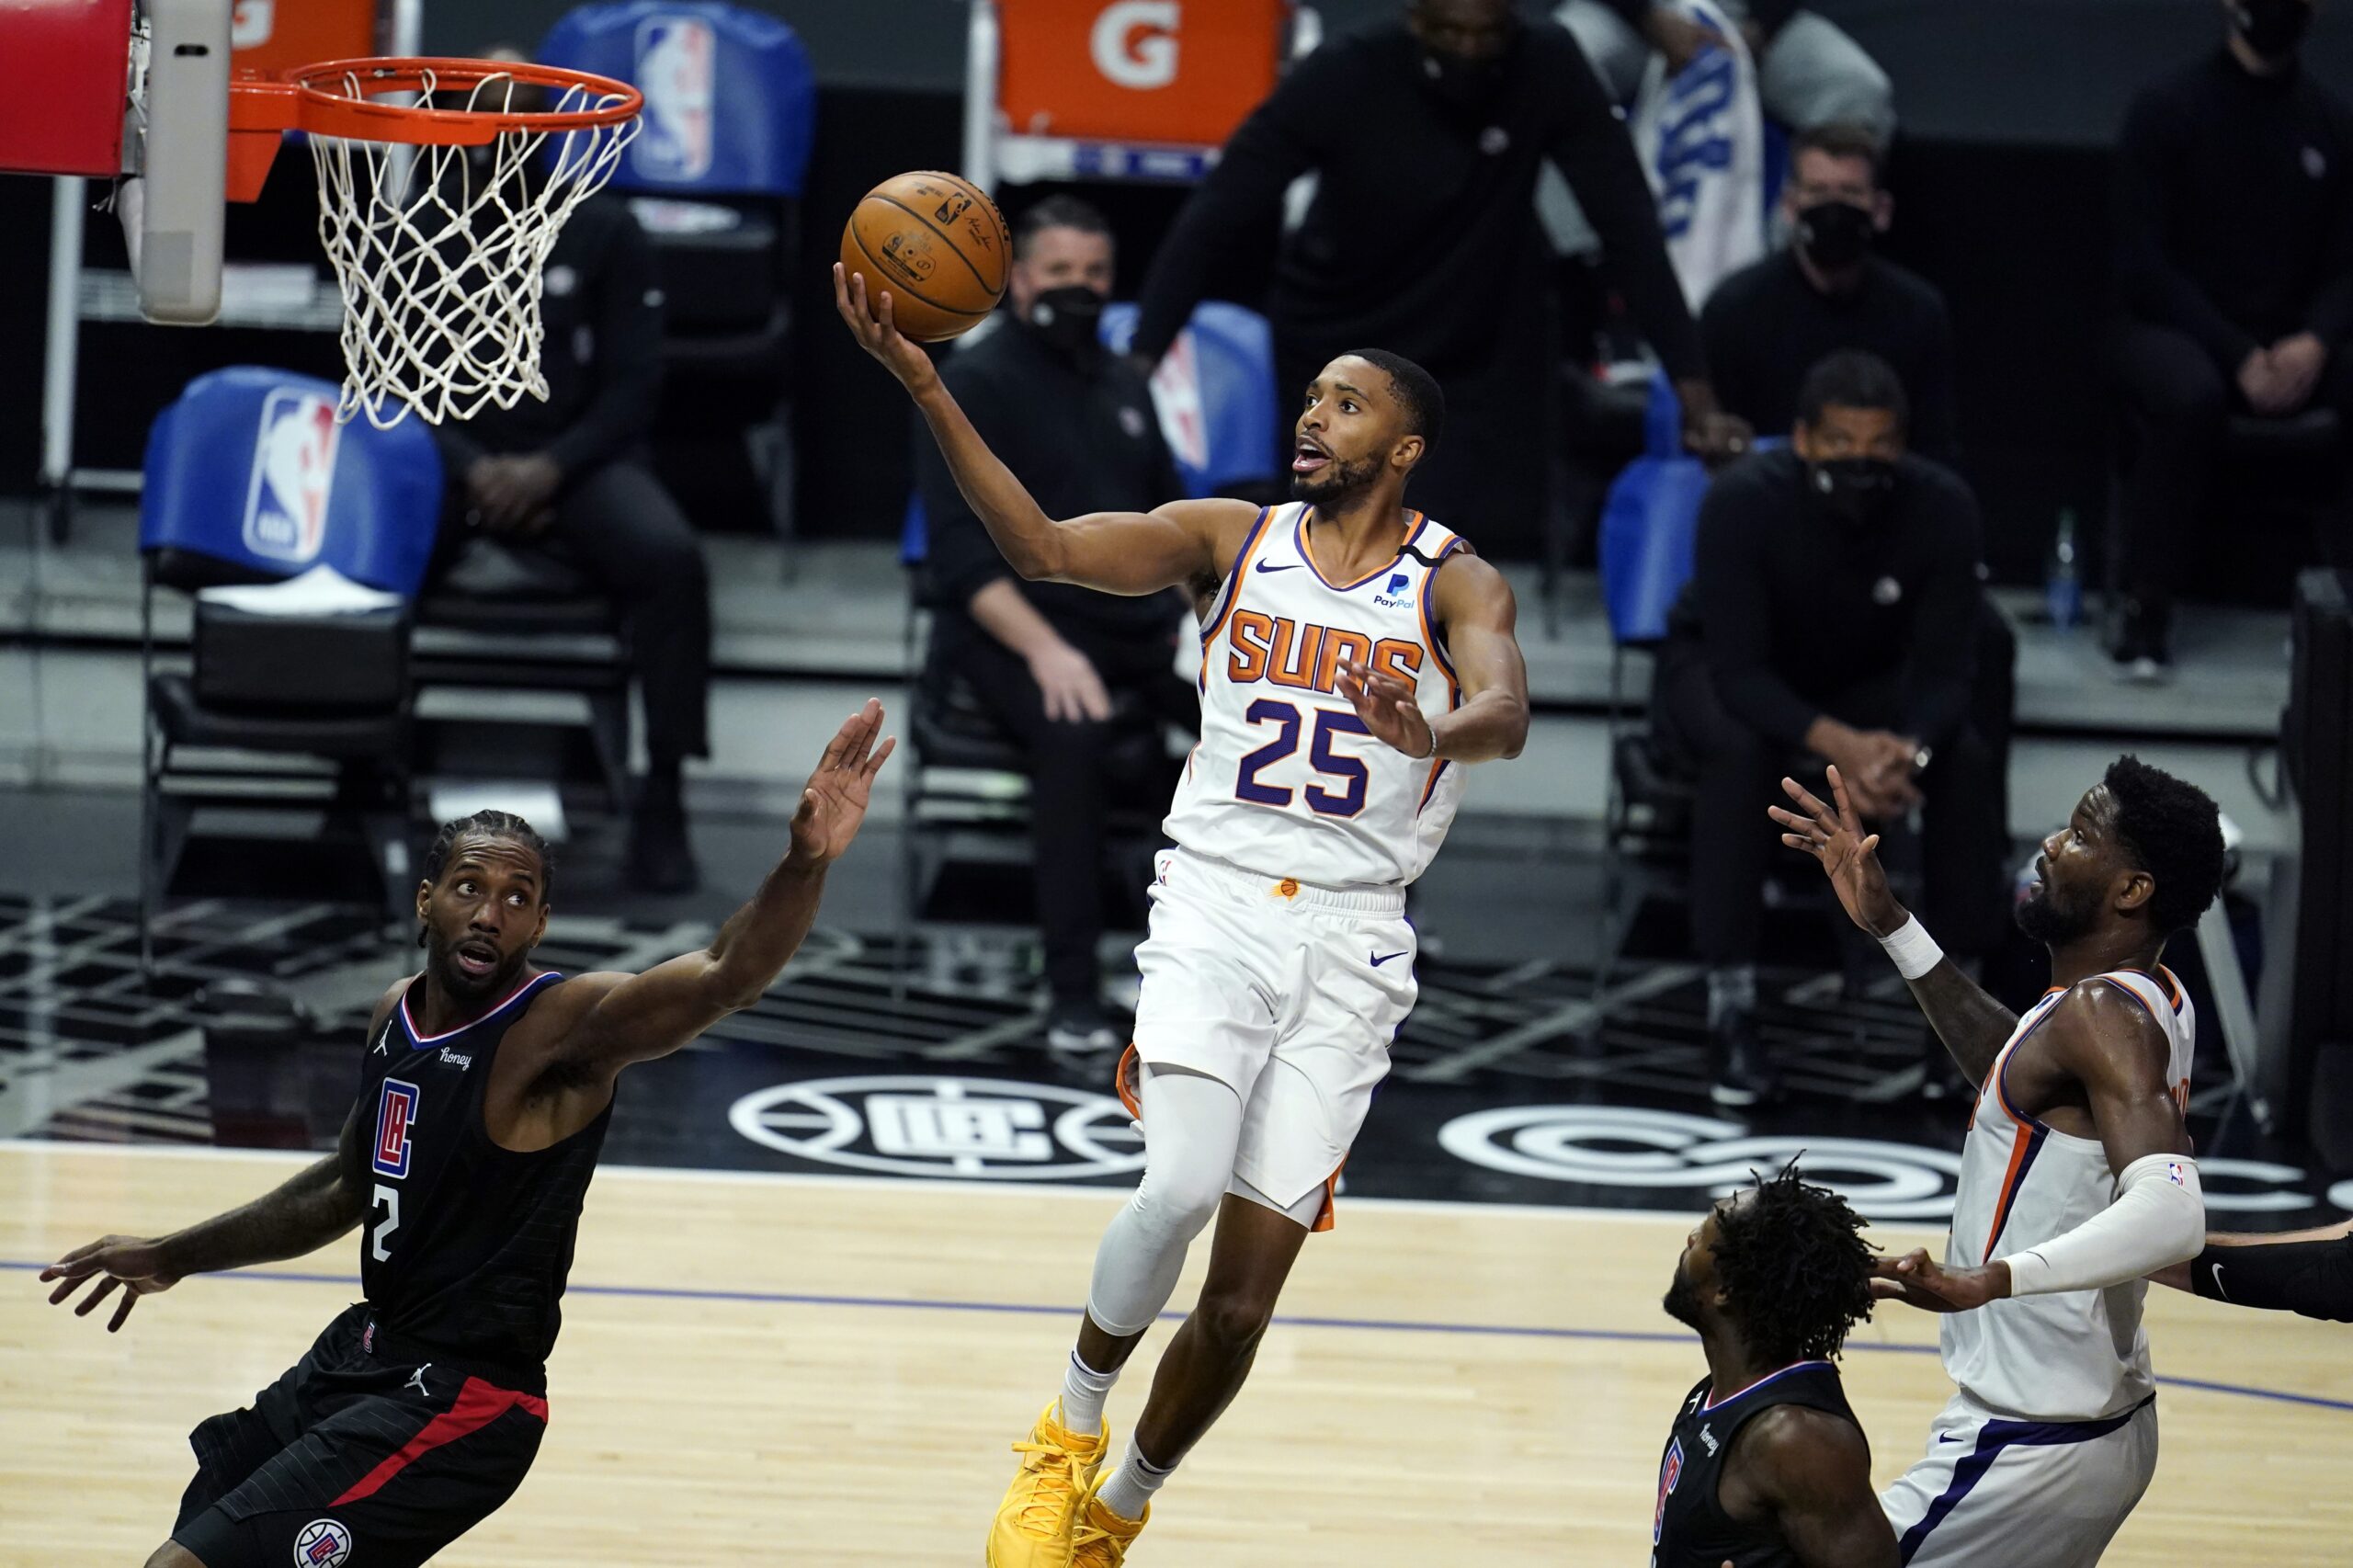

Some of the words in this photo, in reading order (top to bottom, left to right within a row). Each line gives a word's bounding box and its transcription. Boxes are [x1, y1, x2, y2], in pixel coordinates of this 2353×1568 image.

[1090, 0, 1179, 88] G
[1373, 596, 1415, 608] PayPal
[1228, 608, 1425, 696] SUNS
[1235, 698, 1370, 819] 25
[440, 1046, 472, 1071] honey
[372, 1184, 399, 1262] 2
